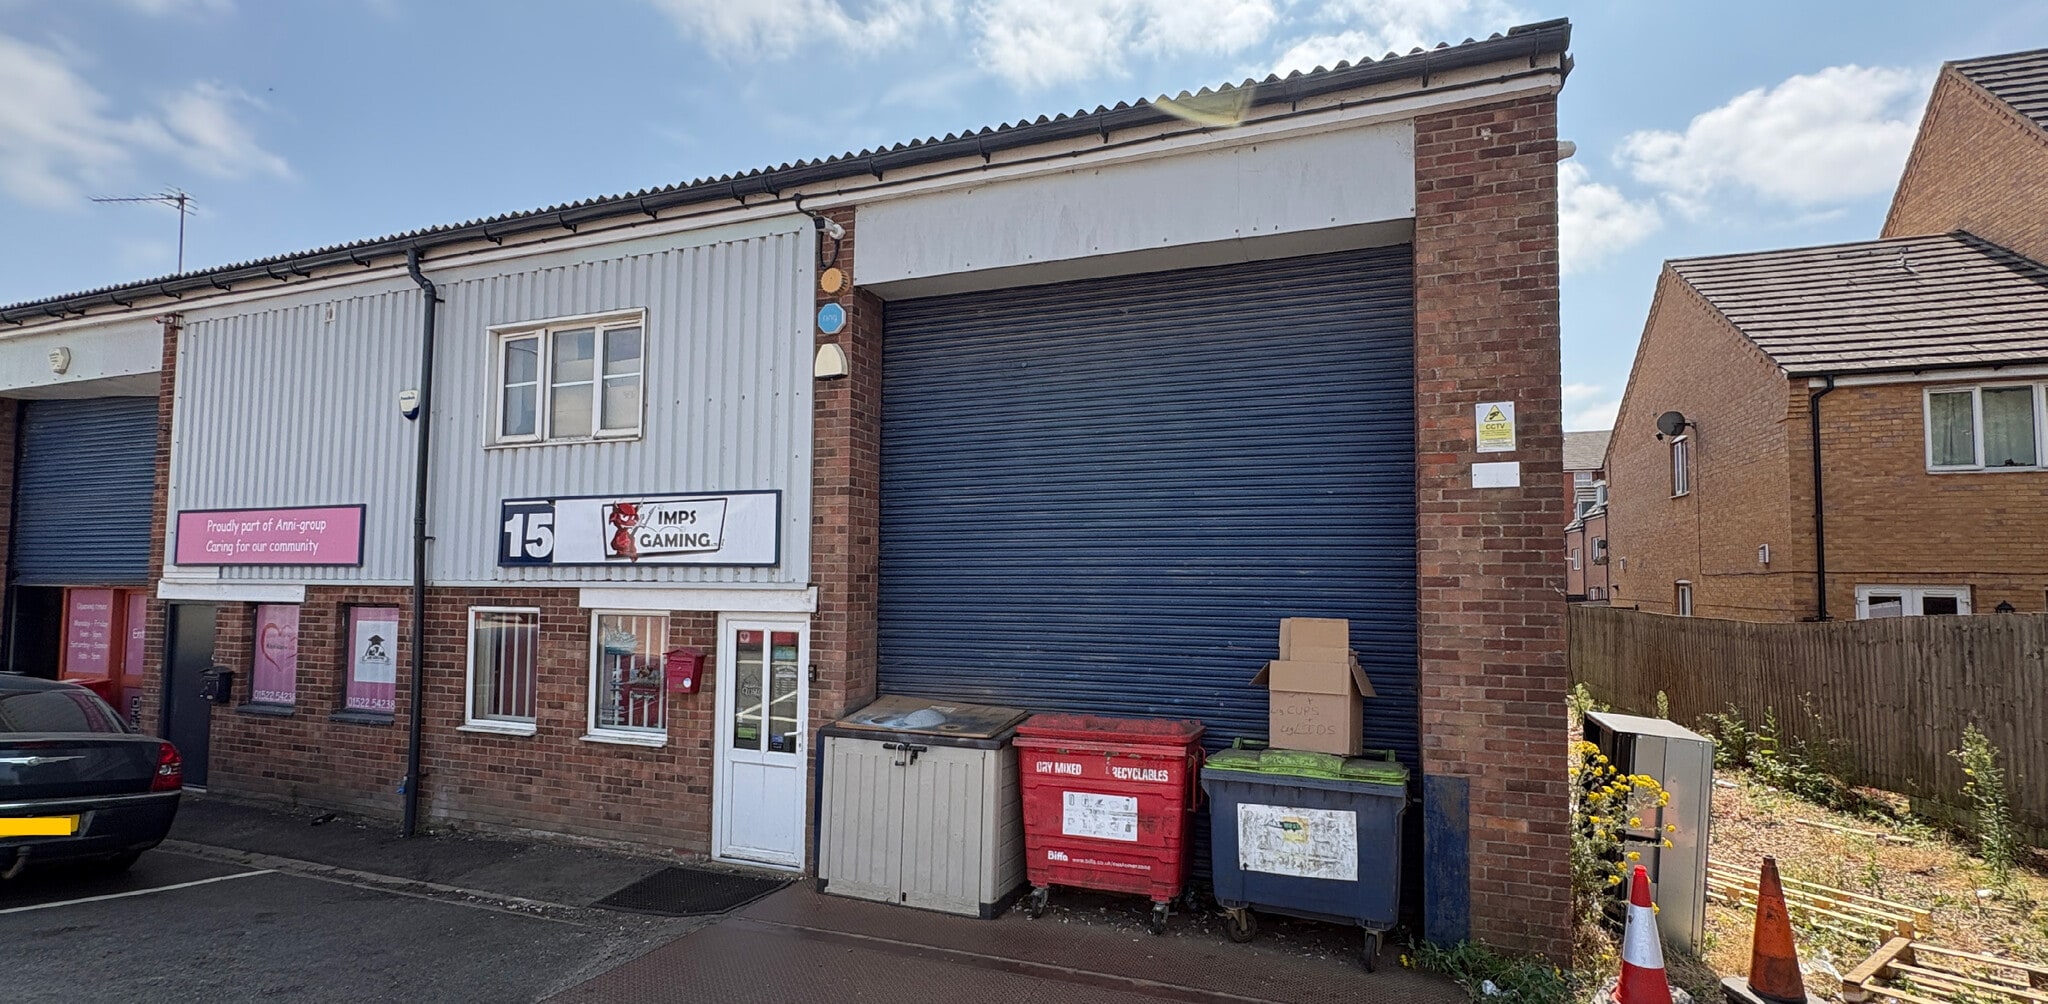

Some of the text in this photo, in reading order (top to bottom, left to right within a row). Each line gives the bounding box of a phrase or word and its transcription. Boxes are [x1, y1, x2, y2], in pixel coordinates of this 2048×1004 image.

[658, 510, 697, 525] IMPS
[207, 518, 327, 535] Proudly part of Anni-group
[504, 513, 554, 558] 15
[640, 533, 710, 548] GAMING
[206, 540, 319, 556] Caring for our community
[254, 690, 274, 700] 01522
[348, 697, 396, 710] 01522 54238
[1036, 761, 1169, 782] DRY MIXED RECYCLABLES
[1047, 850, 1069, 862] Biffa
